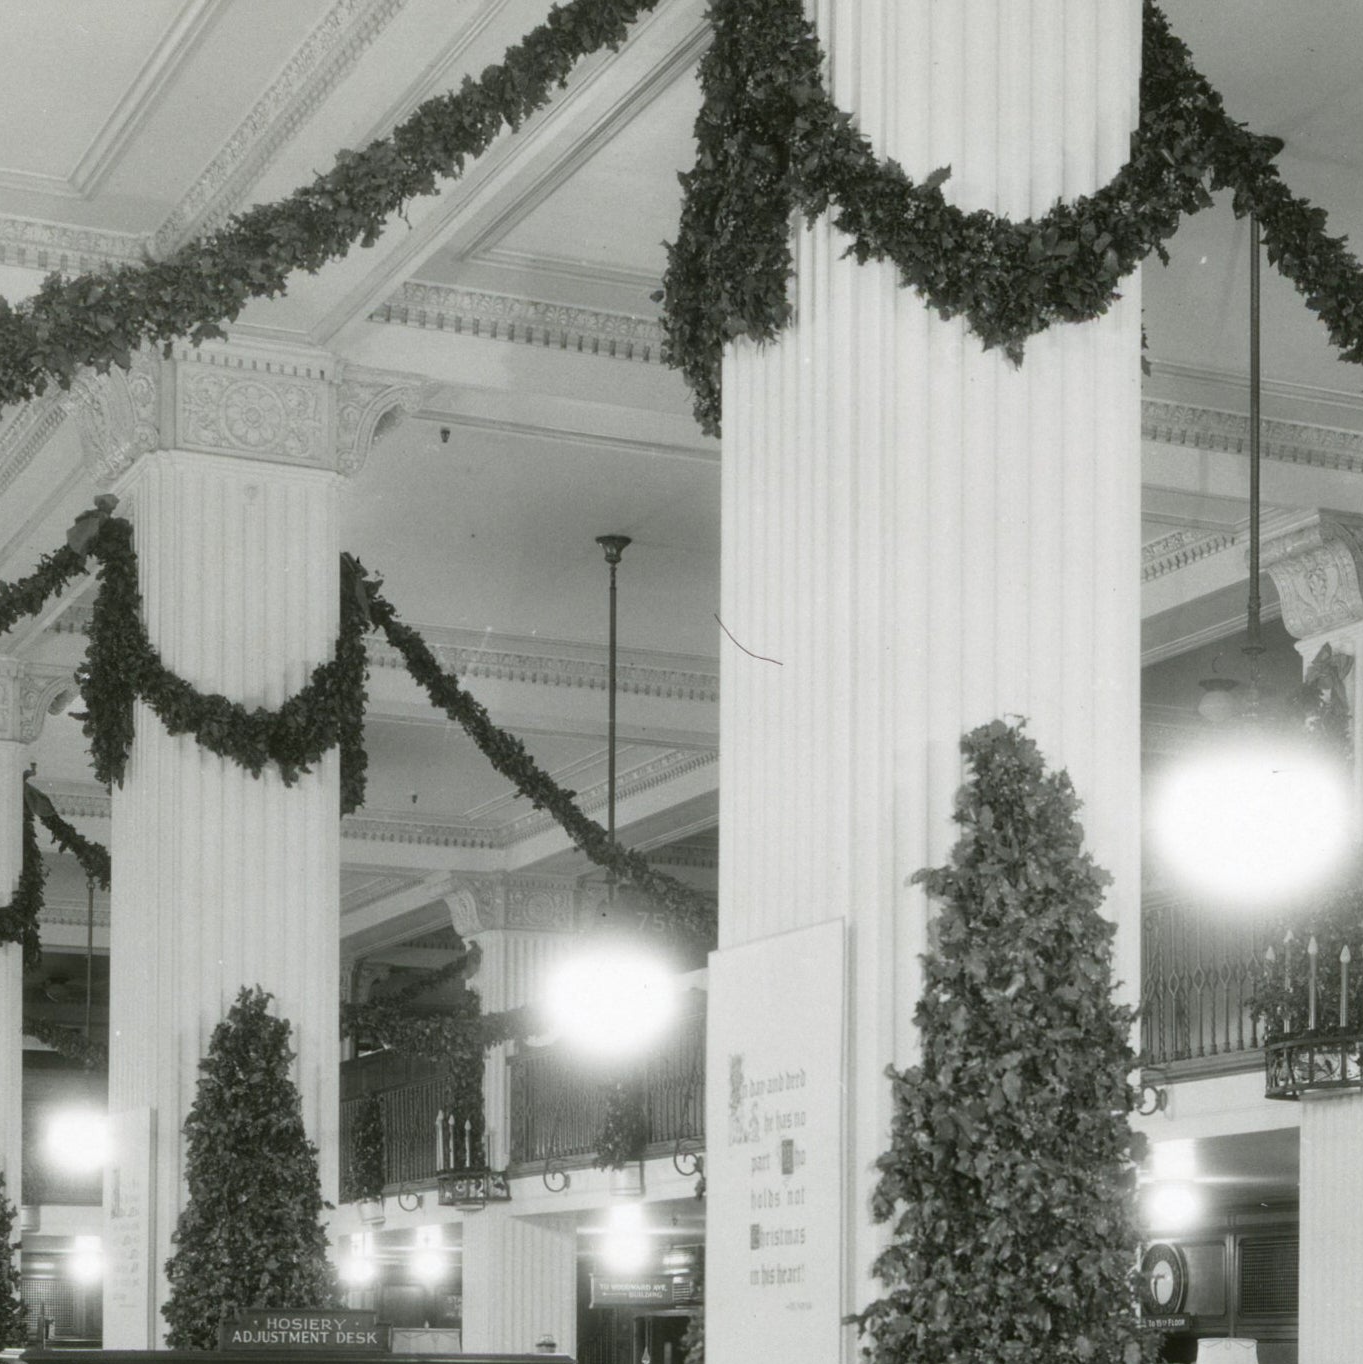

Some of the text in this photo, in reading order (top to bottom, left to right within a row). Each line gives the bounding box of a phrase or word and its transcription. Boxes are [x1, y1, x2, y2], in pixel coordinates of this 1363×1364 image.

[766, 1071, 784, 1094] and
[776, 1108, 793, 1132] has
[794, 1110, 806, 1128] no
[750, 1184, 806, 1209] holds not
[750, 1223, 806, 1251] Christmas
[761, 1263, 776, 1287] his
[266, 1317, 347, 1331] HOSIERY
[1168, 1318, 1185, 1327] FLOOR
[232, 1330, 378, 1344] ADJUSTMENT DESK
